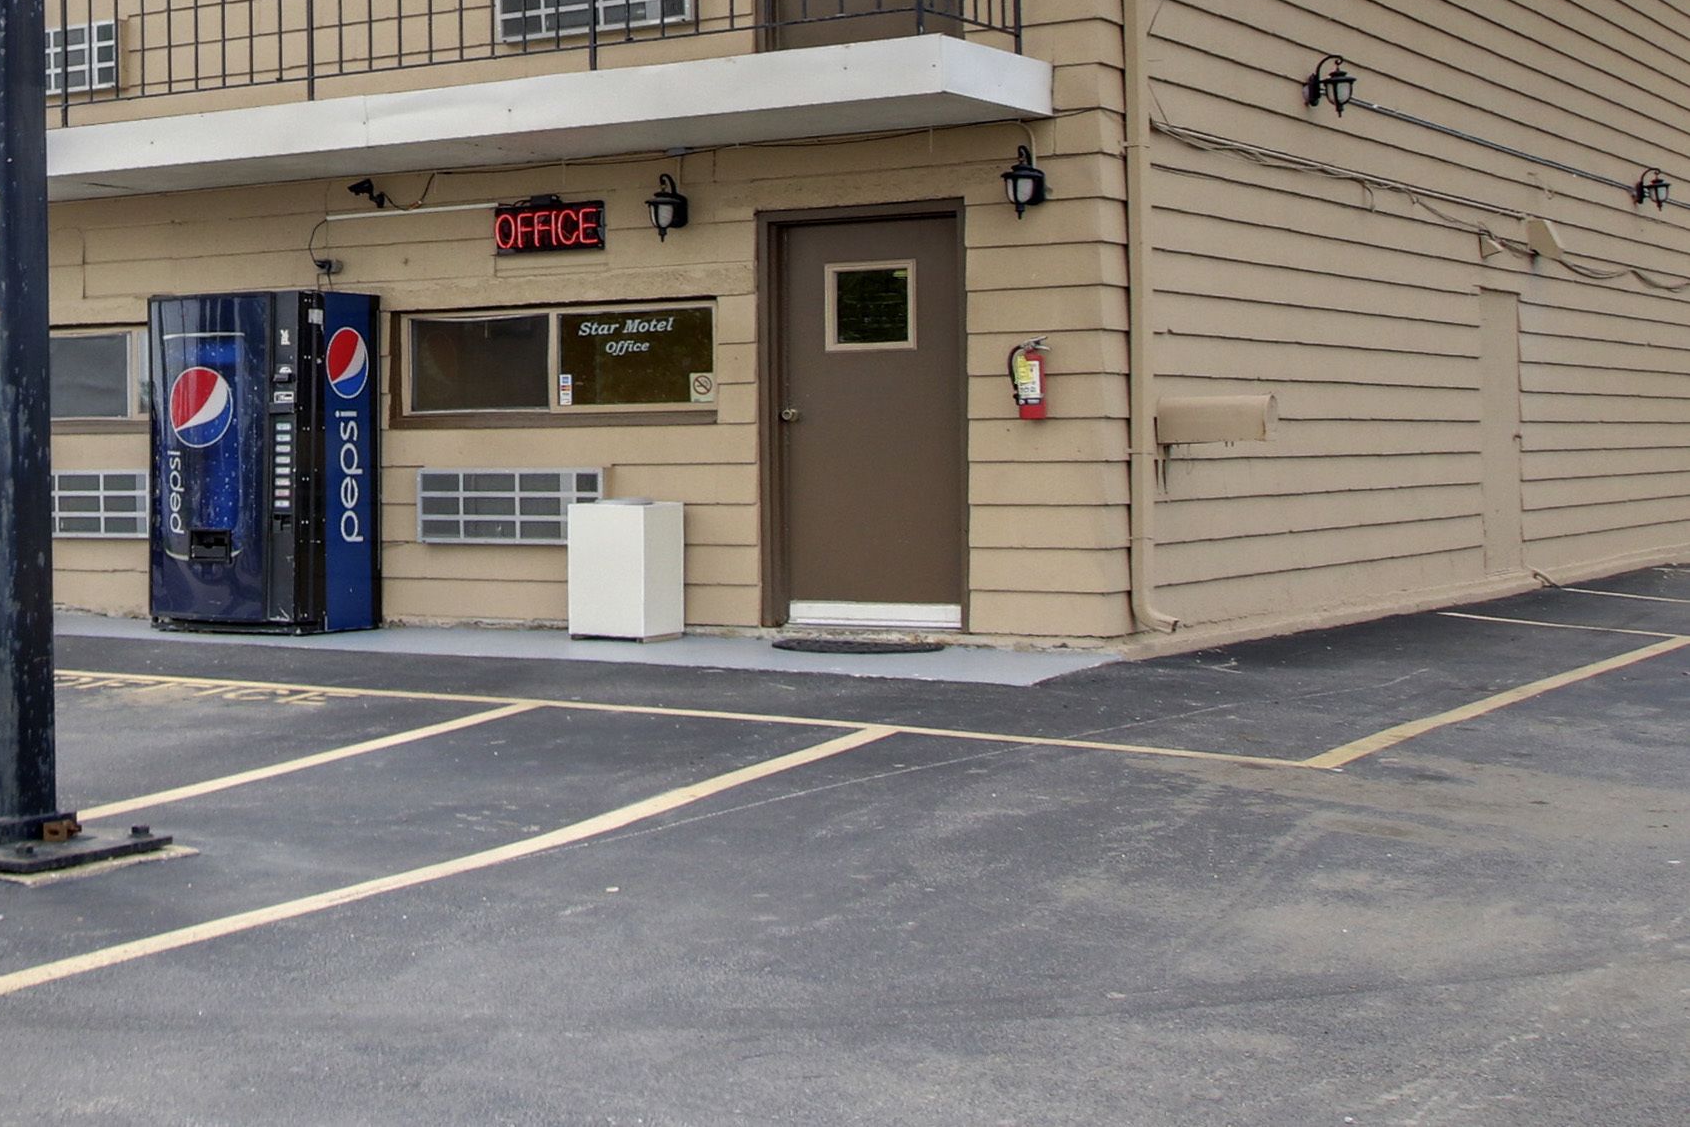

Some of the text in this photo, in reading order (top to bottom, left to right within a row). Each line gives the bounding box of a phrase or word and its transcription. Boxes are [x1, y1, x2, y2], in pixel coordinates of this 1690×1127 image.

[495, 208, 598, 249] OFFICE
[578, 316, 674, 336] Star Motel
[605, 340, 650, 356] Office
[167, 450, 185, 534] pepsi
[335, 410, 364, 543] pepsi
